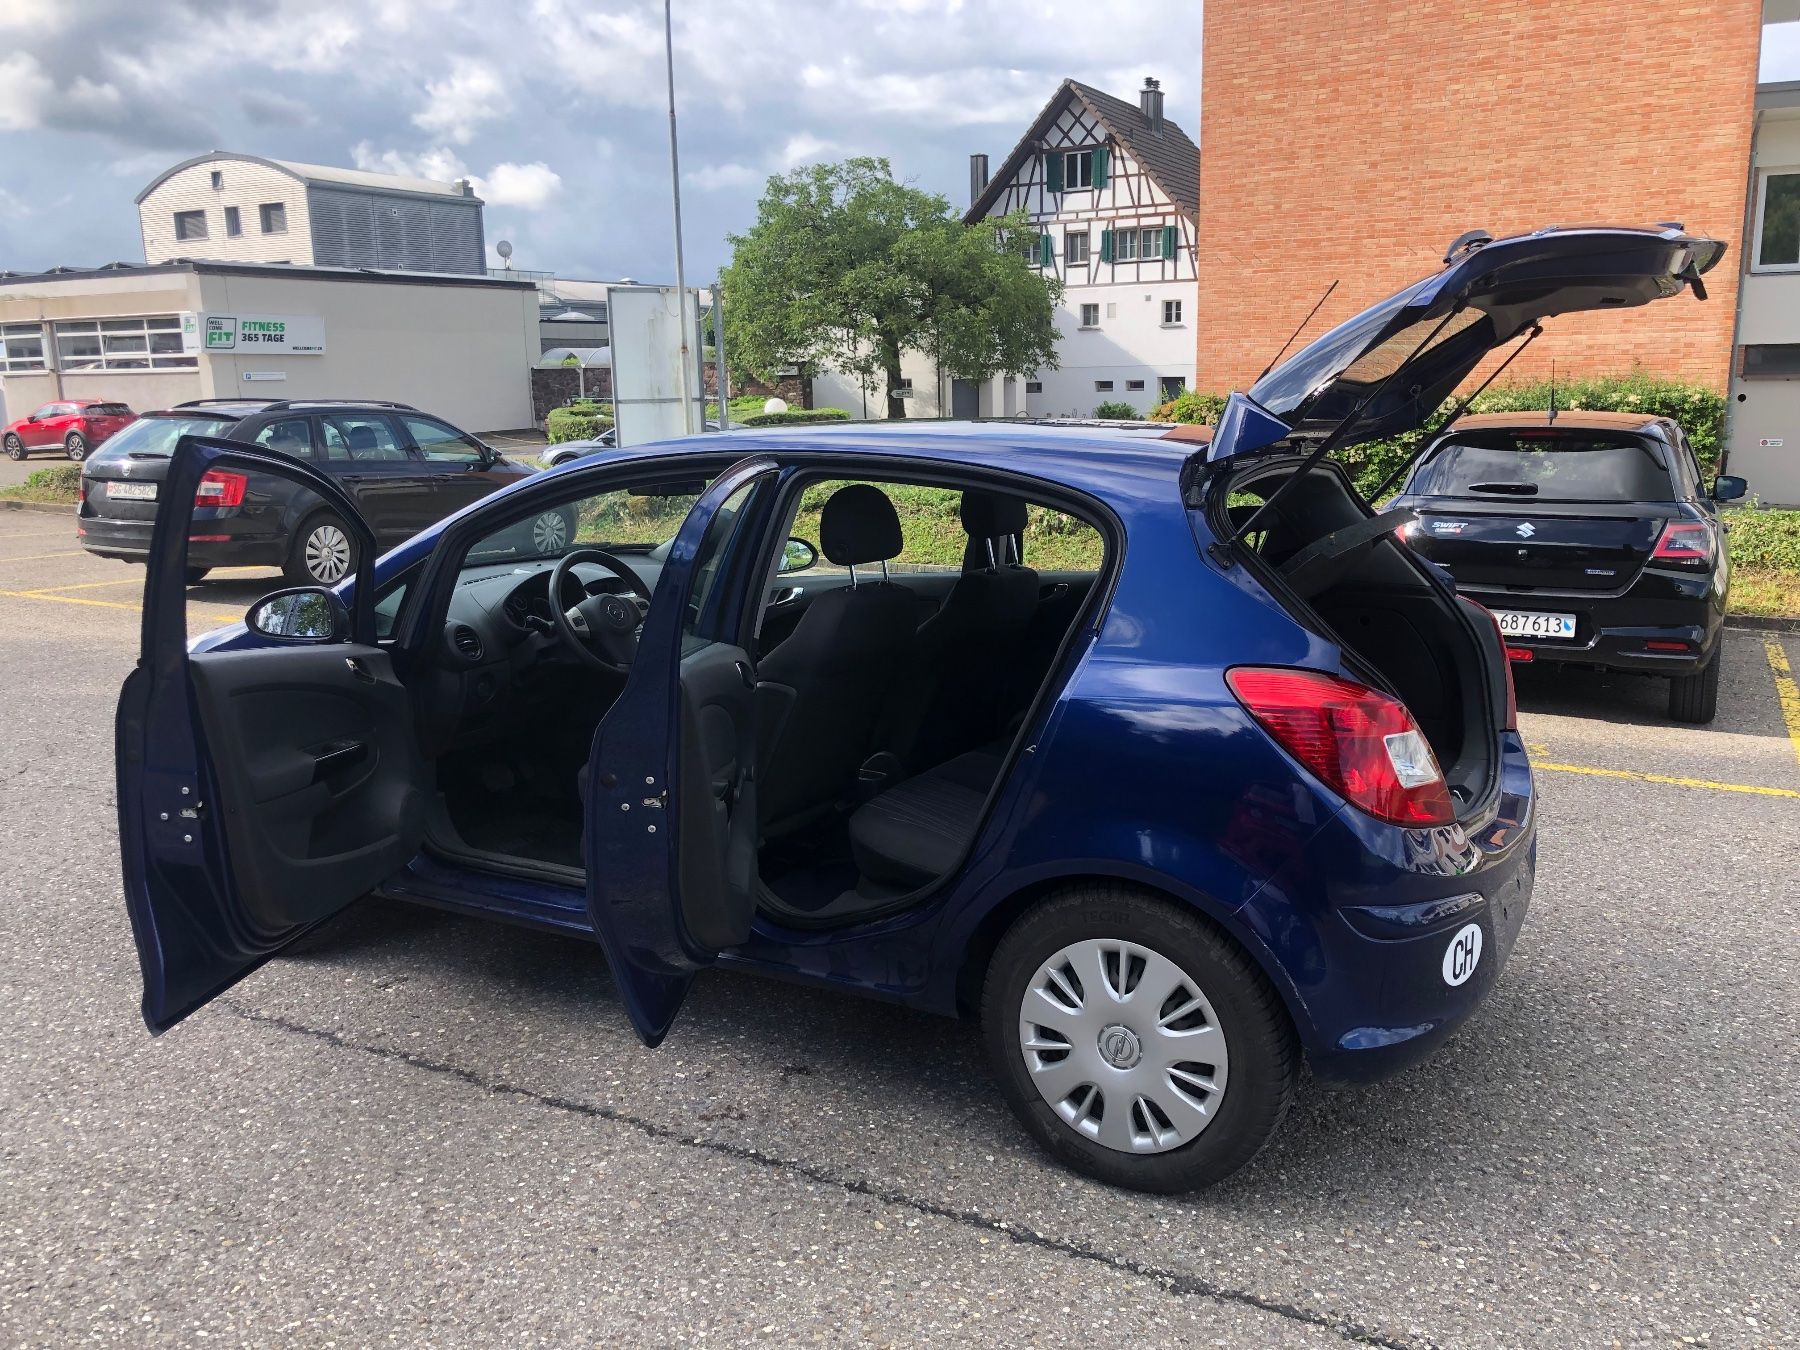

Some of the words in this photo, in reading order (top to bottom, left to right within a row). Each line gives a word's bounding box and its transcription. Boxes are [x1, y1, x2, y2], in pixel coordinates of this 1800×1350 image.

[241, 321, 285, 332] FITNESS
[208, 332, 233, 346] FIT
[241, 333, 259, 342] 365
[262, 333, 285, 342] TAGE
[1431, 521, 1469, 529] SWIFT
[1500, 613, 1562, 633] 687613
[1452, 930, 1475, 981] CH
